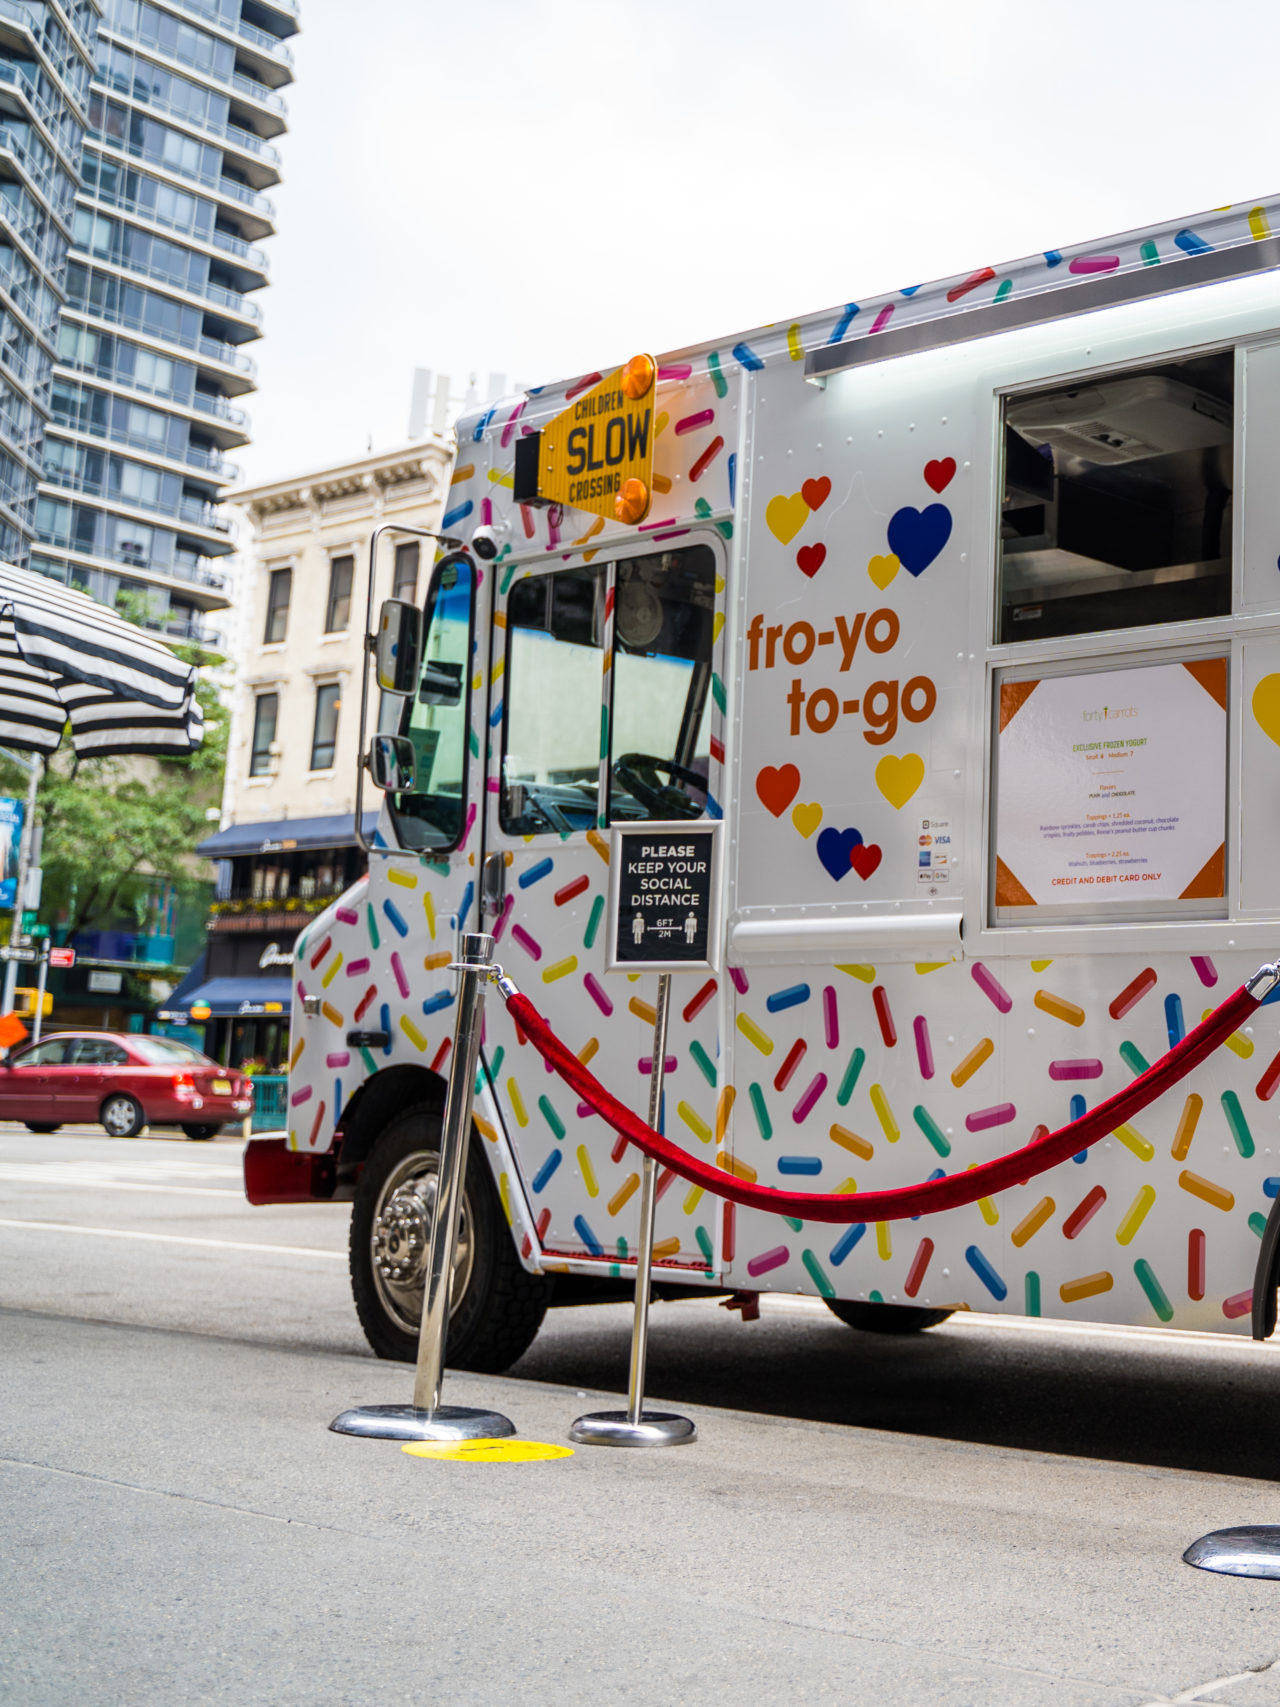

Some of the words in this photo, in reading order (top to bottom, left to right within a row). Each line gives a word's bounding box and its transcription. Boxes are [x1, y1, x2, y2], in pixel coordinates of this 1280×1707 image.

[575, 390, 624, 421] CHILDREN
[566, 408, 651, 475] SLOW
[569, 472, 621, 503] CROSSING
[747, 608, 900, 672] fro-yo
[787, 675, 937, 746] to-go
[1126, 737, 1147, 748] YOGURT
[934, 836, 951, 845] VISA
[641, 846, 695, 858] PLEASE
[628, 862, 664, 874] KEEP
[667, 861, 707, 873] YOUR
[640, 878, 692, 890] SOCIAL
[1051, 878, 1077, 886] CREDIT
[1078, 876, 1094, 885] AND
[1096, 875, 1118, 884] DEBIT
[1119, 874, 1140, 883] CARD
[1141, 873, 1162, 881] ONLY
[631, 894, 700, 906] DISTANCE
[656, 918, 674, 927] 6FT
[658, 930, 672, 938] 2M
